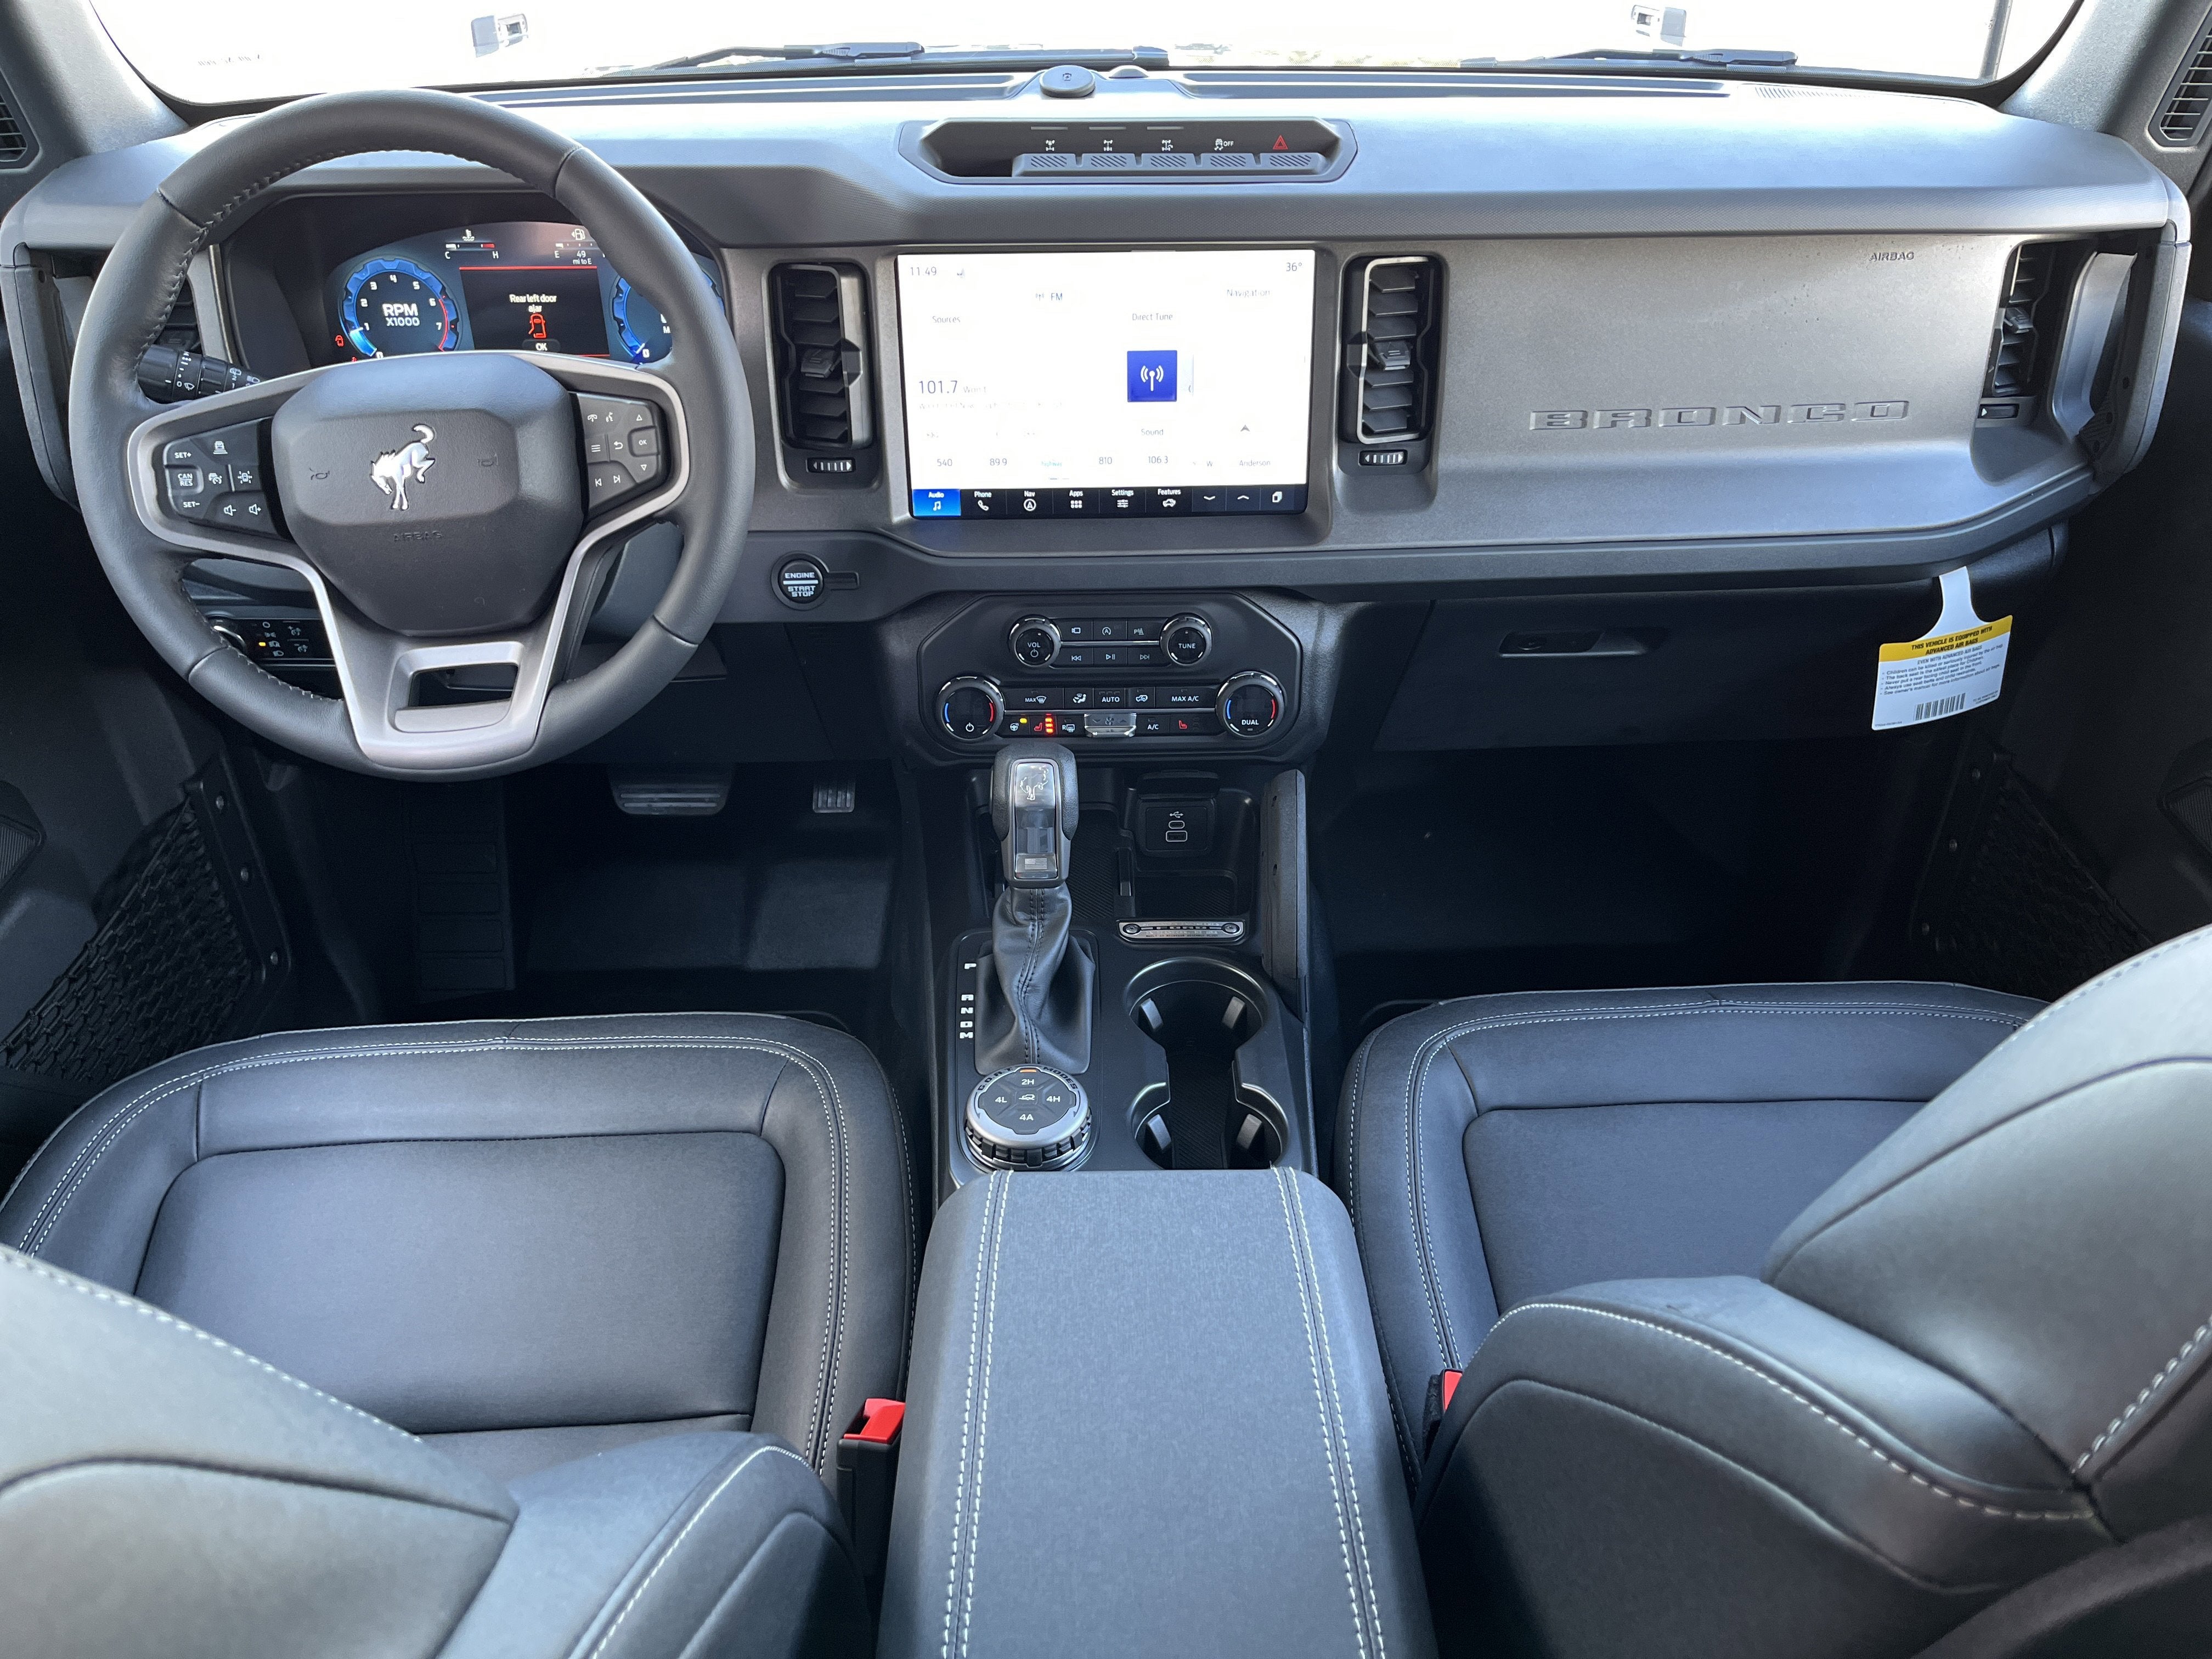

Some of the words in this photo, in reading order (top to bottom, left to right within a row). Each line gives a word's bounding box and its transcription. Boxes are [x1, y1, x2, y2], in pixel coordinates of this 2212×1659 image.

[445, 251, 450, 259] C
[1869, 251, 1914, 262] AIRBAG
[370, 281, 377, 290] 3
[413, 281, 420, 290] 5
[509, 294, 526, 303] Rear
[527, 294, 540, 302] left
[540, 294, 557, 302] door
[1051, 292, 1063, 301] FM
[360, 298, 368, 307] 2
[429, 298, 436, 306] 6
[382, 304, 418, 316] RPM
[528, 304, 542, 313] ajar
[386, 317, 420, 326] X1000
[1132, 313, 1153, 321] Direct
[364, 323, 369, 331] 1
[535, 342, 548, 351] OK
[919, 380, 958, 394] 101.7
[1530, 400, 1910, 431] BRONCO
[937, 458, 952, 466] 540
[990, 458, 1007, 466] 899
[1099, 456, 1112, 465] 810
[1148, 456, 1169, 464] 1063
[1111, 489, 1134, 497] Settings
[1925, 638, 1948, 648] VEHICLE
[1955, 630, 1979, 641] EQUIPPED
[1980, 625, 1993, 634] WITH
[1925, 645, 1954, 656] ADVANCED
[1965, 637, 1978, 646] BAGS
[1043, 1066, 1078, 1090] MODES
